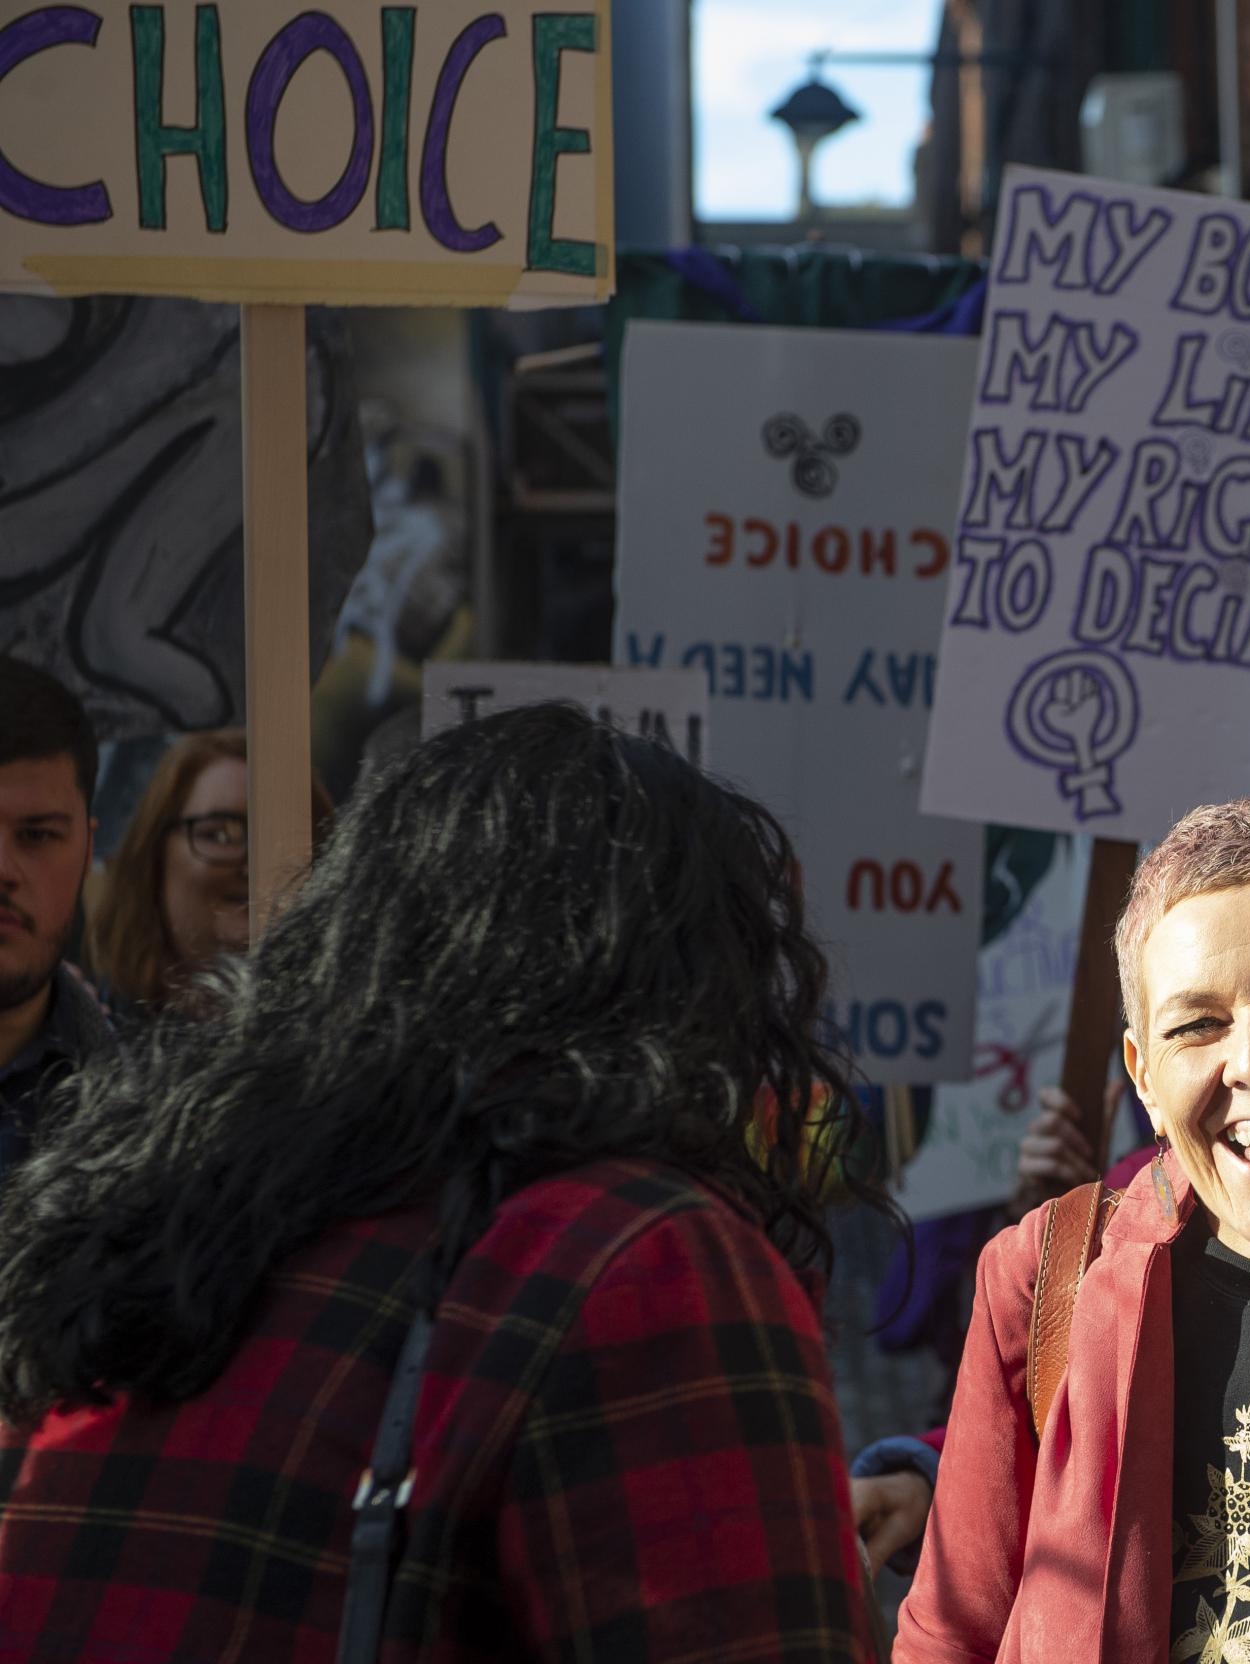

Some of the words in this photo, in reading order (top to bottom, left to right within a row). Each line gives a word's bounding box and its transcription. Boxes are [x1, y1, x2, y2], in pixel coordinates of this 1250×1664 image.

[0, 4, 607, 278] CHOICE
[997, 184, 1172, 295] MY
[980, 310, 1139, 413] MY
[962, 428, 1120, 534] MY
[703, 517, 949, 578] CHOICE
[951, 534, 1052, 632] TO
[847, 860, 963, 914] YOU
